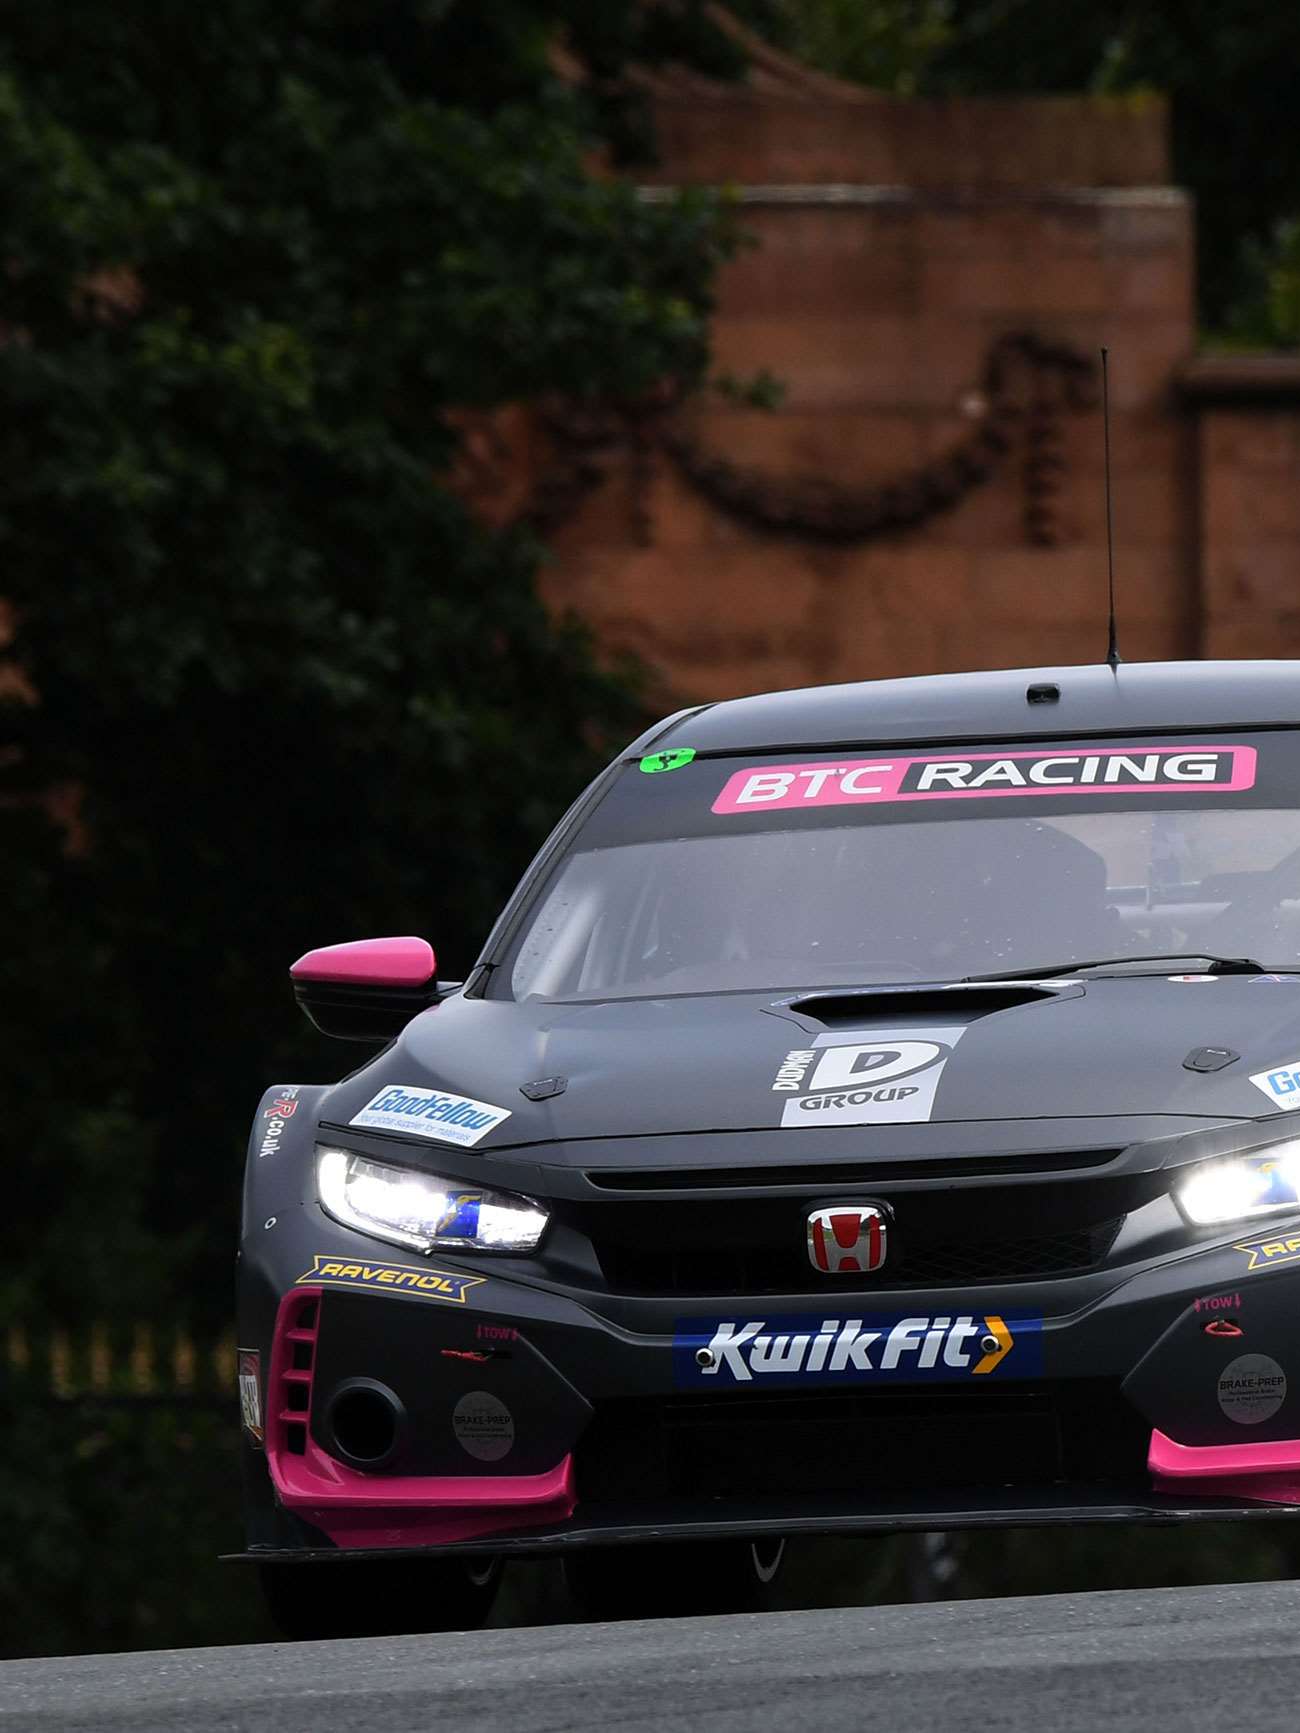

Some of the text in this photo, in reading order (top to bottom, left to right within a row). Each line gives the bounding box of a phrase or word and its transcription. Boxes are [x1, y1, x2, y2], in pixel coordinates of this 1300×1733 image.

[735, 753, 1219, 805] BTC RACING
[772, 1050, 817, 1091] DUDMAN
[799, 1086, 920, 1111] GROUP
[319, 1262, 455, 1293] RAVENOL
[1203, 1296, 1233, 1310] TOW
